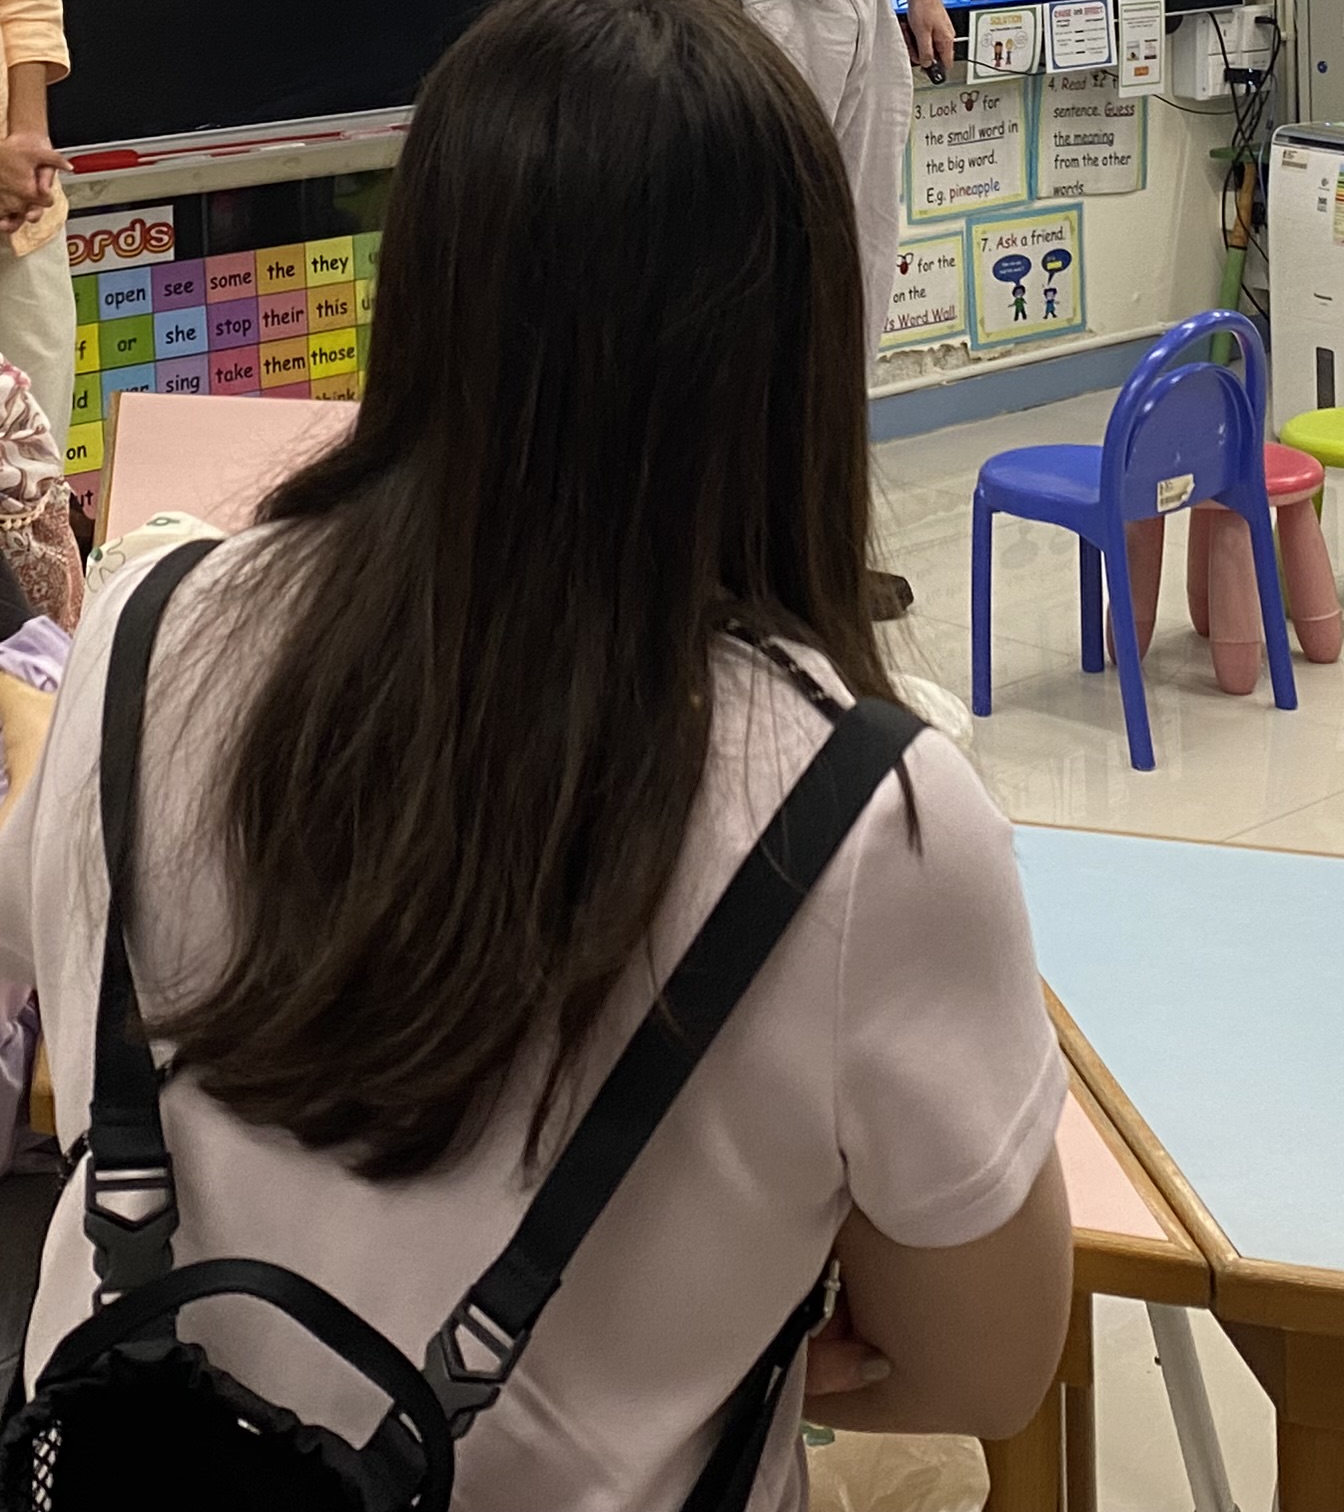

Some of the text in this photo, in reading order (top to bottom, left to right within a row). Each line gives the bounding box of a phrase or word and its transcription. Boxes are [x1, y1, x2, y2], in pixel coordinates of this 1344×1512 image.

[915, 96, 1000, 119] 3. Look for
[1053, 102, 1135, 119] sentence. Guess
[925, 120, 1018, 145] the small word in
[1053, 130, 1114, 147] the meaning
[926, 152, 997, 173] the big word.
[1054, 153, 1131, 169] from the other
[927, 180, 1000, 205] E.g. pineapple
[69, 219, 174, 266] ords
[981, 227, 1066, 252] 7. Ask a friend.
[267, 263, 295, 280] the
[311, 256, 348, 275] they
[917, 255, 955, 272] for the
[164, 280, 194, 296] see
[211, 273, 251, 289] some
[105, 288, 145, 309] open
[263, 307, 304, 327] their
[316, 299, 348, 318] this
[216, 318, 251, 337] stop
[898, 310, 928, 328] Word
[166, 326, 196, 344] she
[117, 338, 136, 352] or
[310, 345, 355, 364] those
[216, 364, 253, 384] take
[264, 355, 305, 374] them
[166, 375, 200, 393] sing
